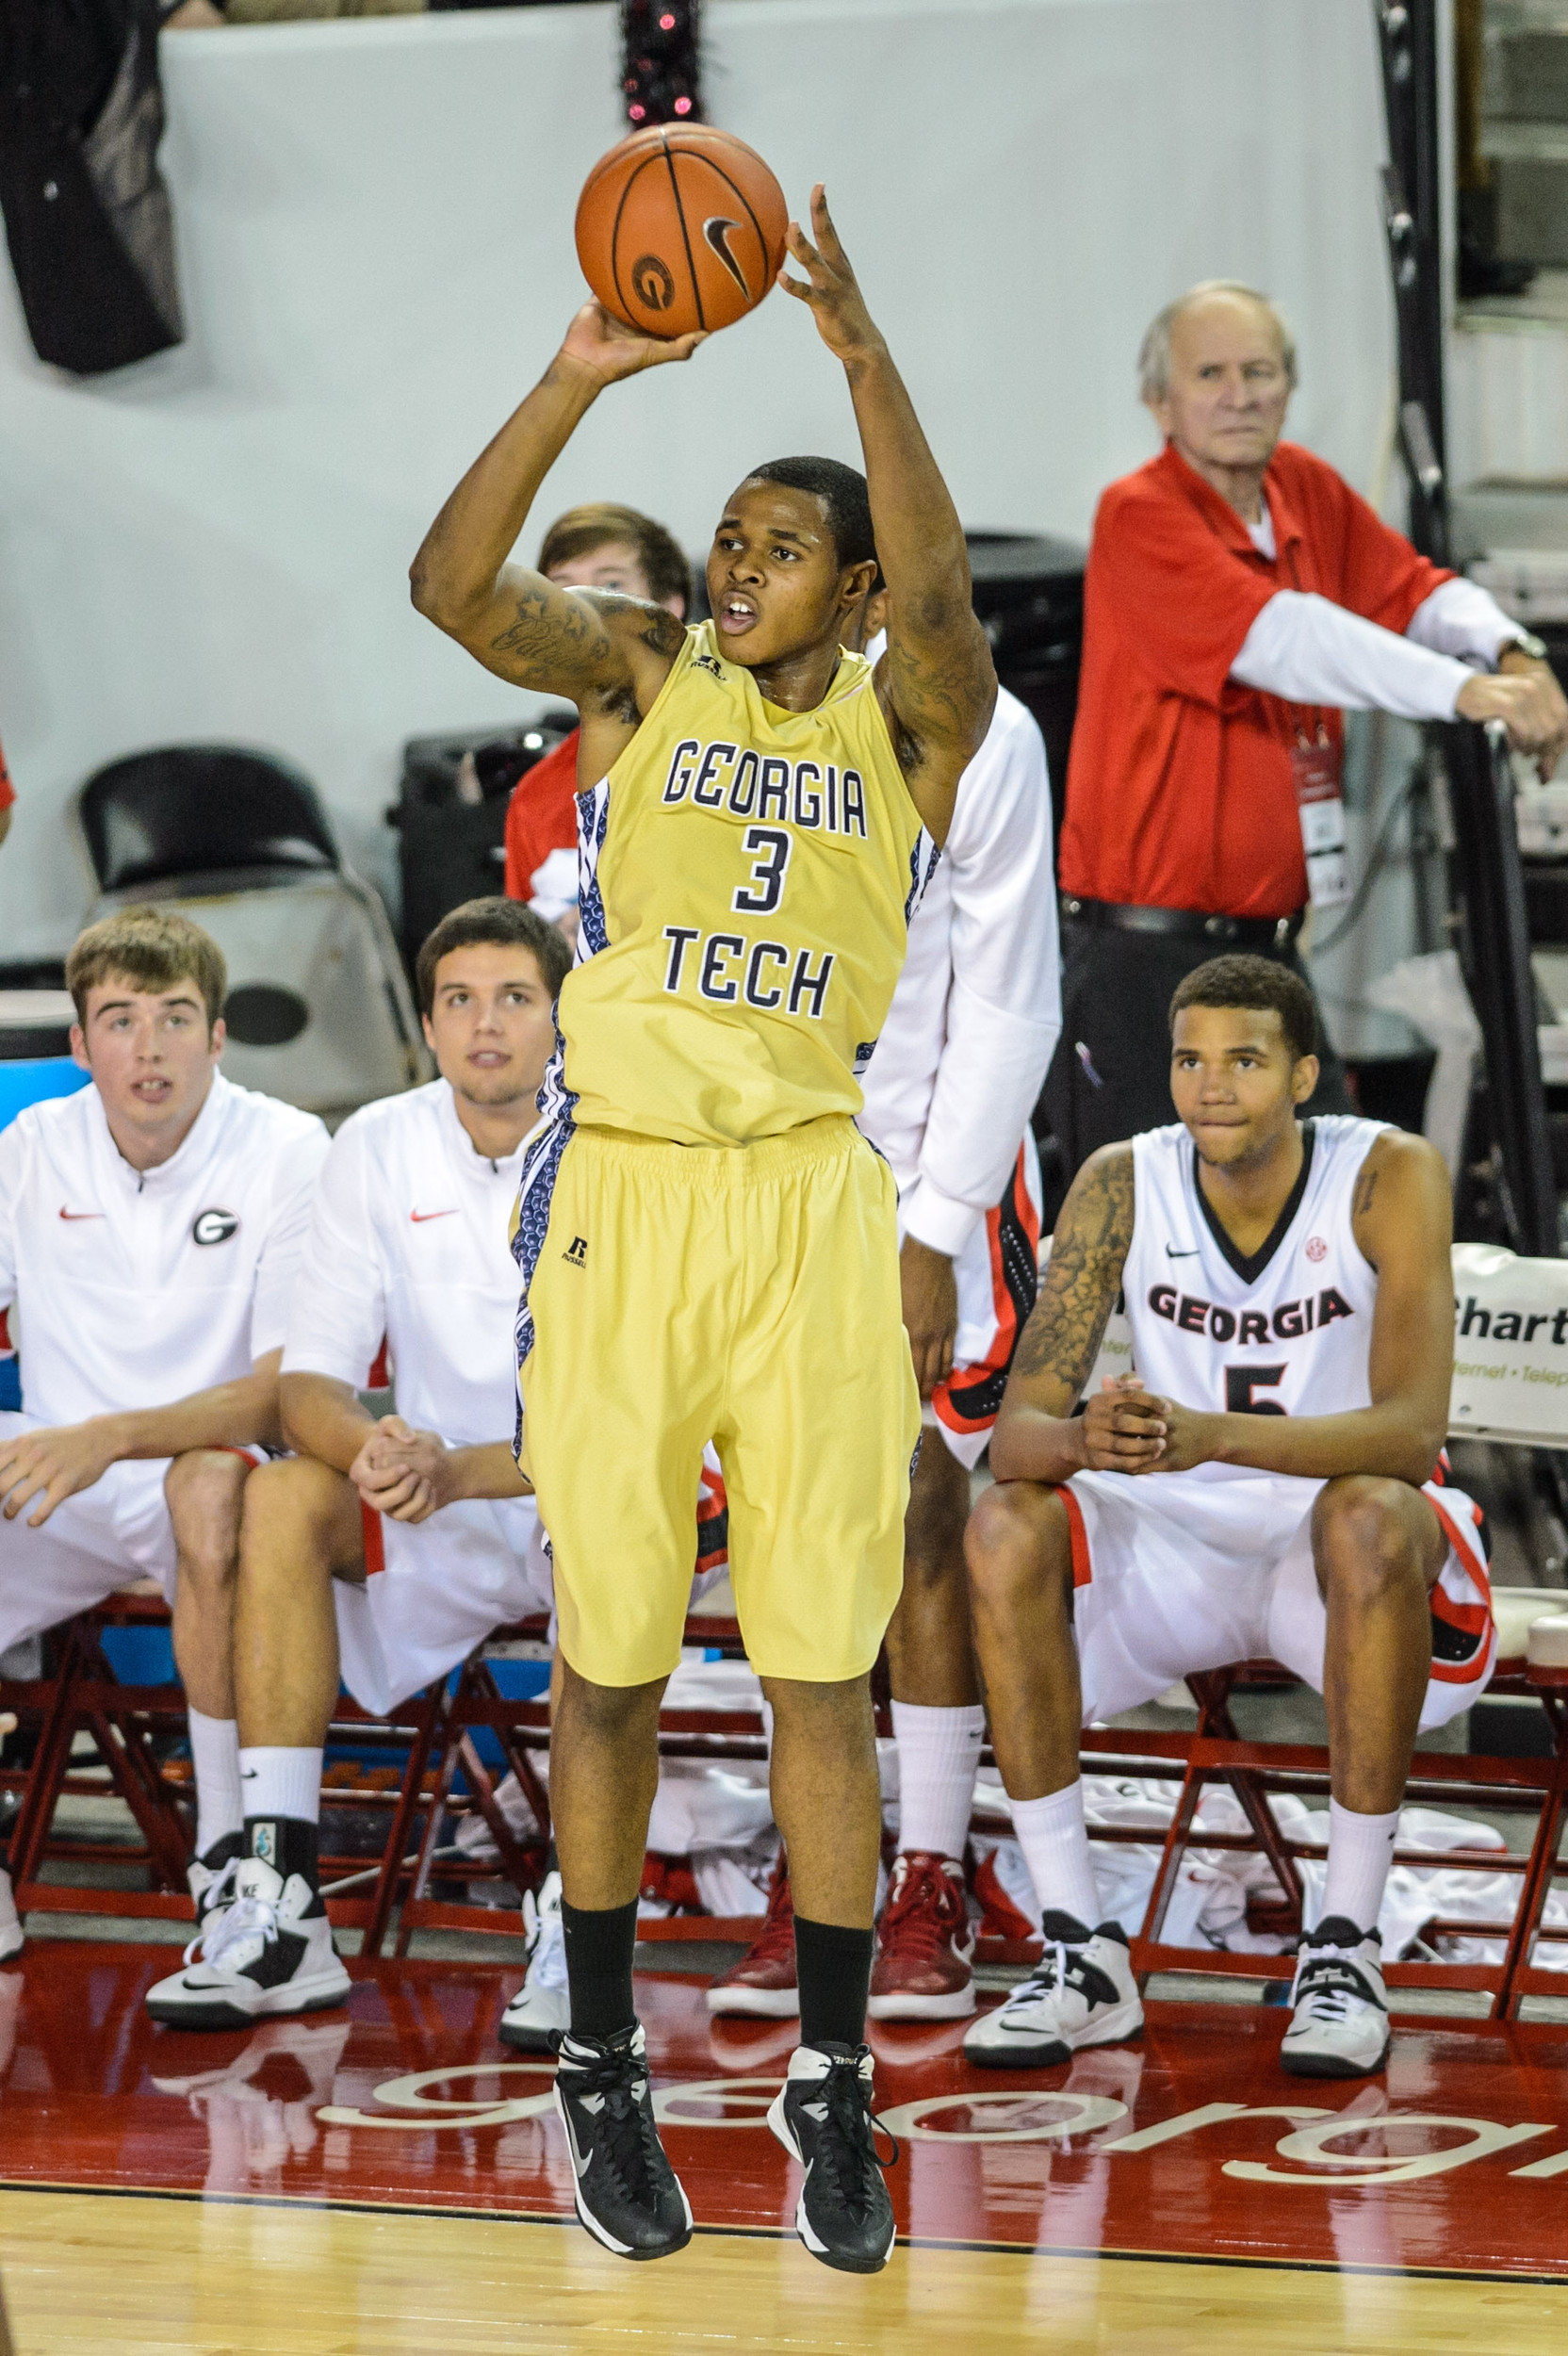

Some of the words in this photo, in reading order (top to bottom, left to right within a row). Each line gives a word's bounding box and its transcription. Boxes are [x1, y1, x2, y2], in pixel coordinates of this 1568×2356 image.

[662, 738, 869, 840] GEORGIA
[731, 824, 793, 917] 3
[662, 924, 837, 1020] TECH
[193, 1207, 238, 1245] G
[568, 1235, 588, 1259] R
[1147, 1283, 1355, 1345] GEORGIA
[1453, 1295, 1568, 1346] hart
